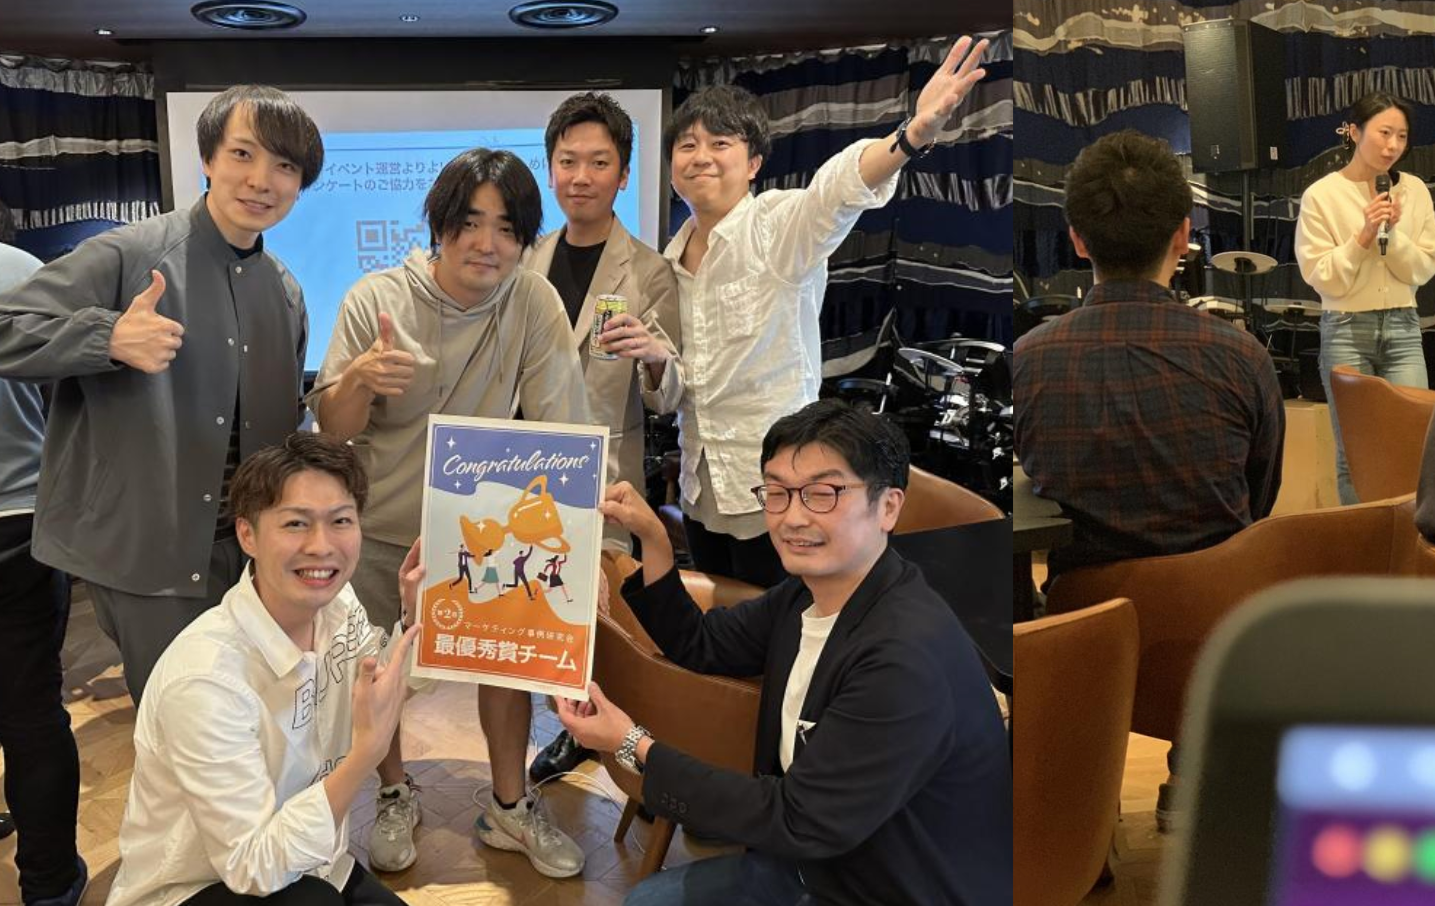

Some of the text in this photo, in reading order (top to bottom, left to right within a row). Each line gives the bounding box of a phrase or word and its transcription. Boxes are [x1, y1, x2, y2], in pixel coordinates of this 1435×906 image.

[325, 161, 443, 176] イベント運営よりよ
[442, 449, 590, 482] Congratulations
[463, 621, 574, 644] マーケティング事例研究会
[434, 633, 577, 672] 最優秀賞チーム
